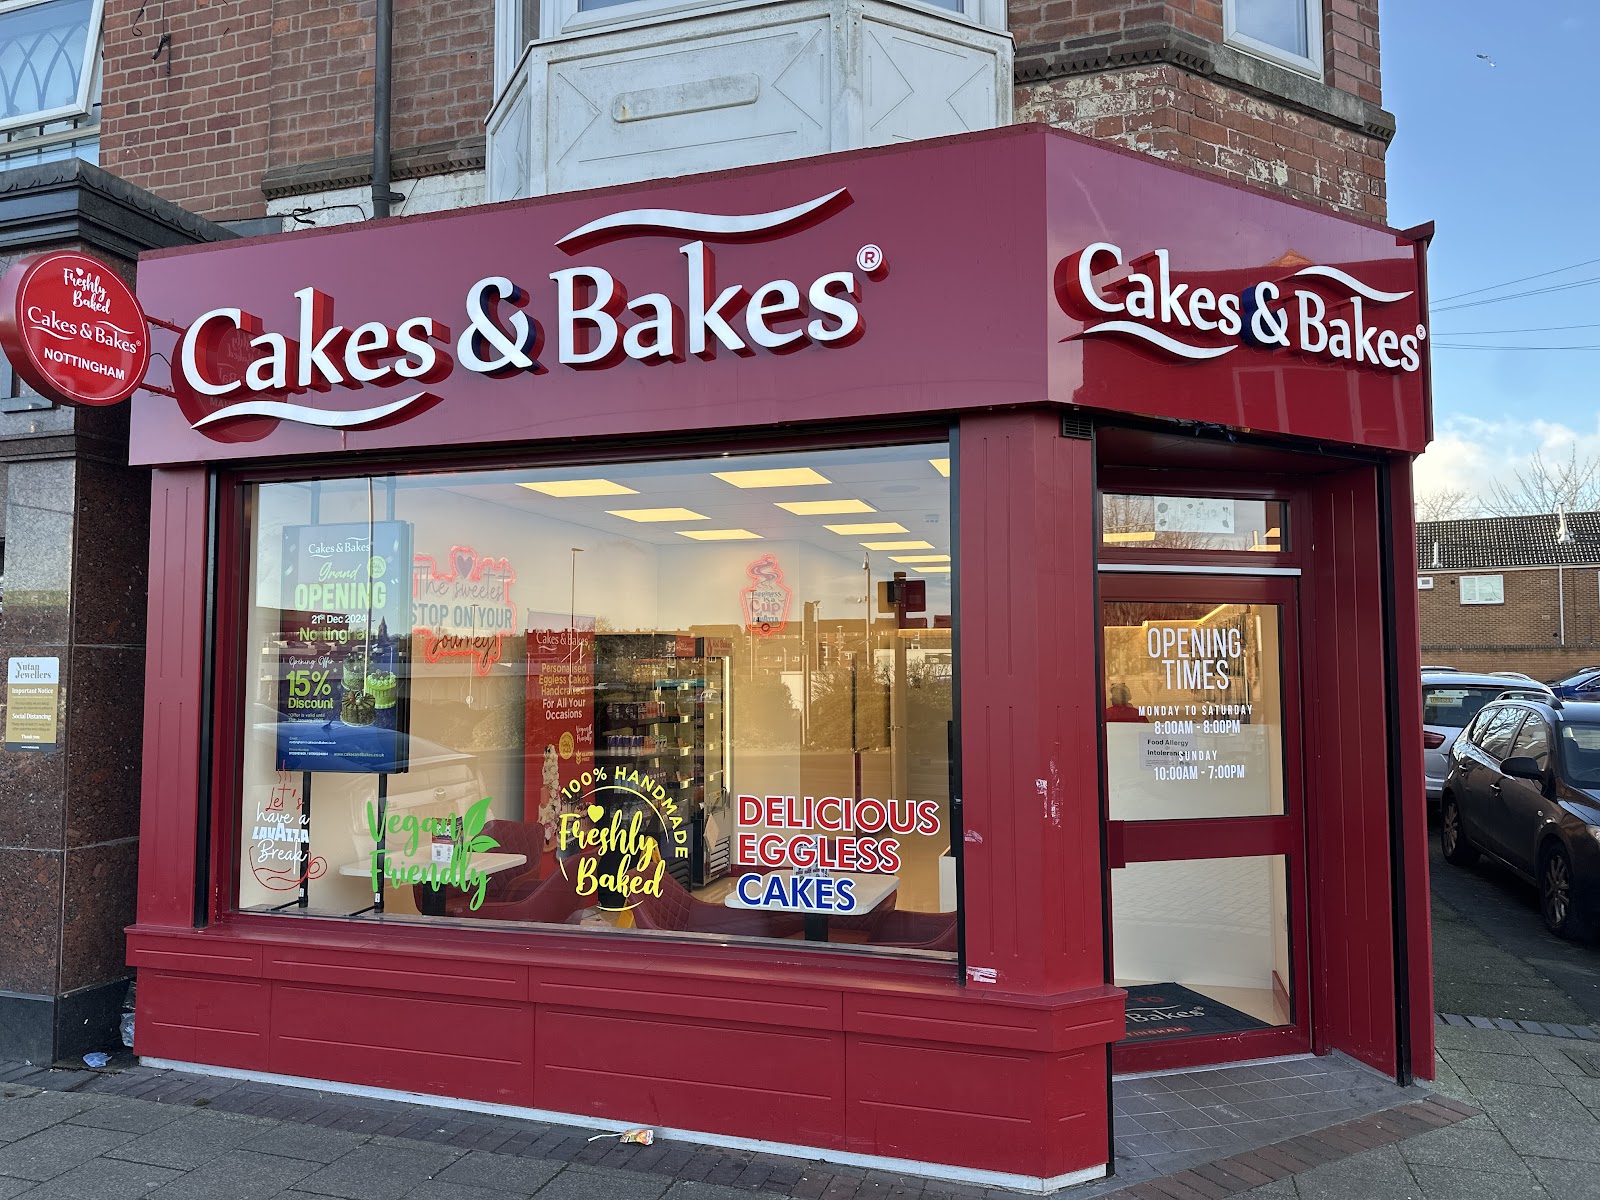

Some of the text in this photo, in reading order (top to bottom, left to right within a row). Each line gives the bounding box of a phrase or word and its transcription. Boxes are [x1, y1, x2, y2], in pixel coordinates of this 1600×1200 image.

[63, 267, 107, 302] Freshly
[1079, 242, 1242, 335] Cakes
[1251, 281, 1290, 347] &
[73, 290, 111, 314] Baked
[28, 306, 77, 335] Cakes
[80, 323, 93, 340] &
[182, 287, 434, 395] Cakes
[457, 276, 533, 373] &
[44, 347, 125, 380] NOTTINGHAM
[309, 542, 334, 554] Cakes
[336, 542, 343, 553] &
[319, 561, 361, 582] Grand
[295, 581, 386, 611] OPENING
[413, 566, 449, 601] The
[453, 566, 511, 602] sweetest
[311, 613, 366, 624] 21st Dec 2024
[409, 603, 512, 629] STOP ON YOUR
[749, 600, 780, 615] Cup
[300, 626, 378, 645] Nottingha
[536, 632, 559, 645] Cakes
[560, 632, 566, 645] &
[1147, 627, 1241, 659] OPENING
[16, 662, 40, 671] Nutan
[289, 655, 334, 669] Opening Offer
[541, 663, 586, 674] Personaised
[15, 670, 52, 679] Jewellers
[539, 674, 566, 686] Eggless
[1162, 659, 1230, 690] TIMES
[288, 698, 333, 709] Discount
[543, 698, 586, 709] For All Your
[545, 709, 582, 720] Occasions
[1138, 704, 1253, 717] MONDAY TO SATURDAY
[1154, 720, 1193, 735] 8:00AM
[1203, 719, 1241, 734] 8:00PM
[1165, 739, 1189, 747] Allergy
[1178, 750, 1218, 761] SUNDAY
[1154, 766, 1198, 780] 10:00AM
[1208, 765, 1245, 779] 7:00PM
[265, 783, 305, 811] Let's
[256, 801, 310, 825] have a
[561, 765, 688, 858] 100% HANDMADE
[738, 794, 941, 836] DELICIOUS
[252, 822, 309, 843] LAVAZZA
[366, 800, 462, 857] Vegan
[559, 809, 658, 872] Freshly
[257, 838, 307, 875] Break
[737, 832, 901, 874] EGGLESS
[369, 840, 491, 911] Friendly
[576, 854, 665, 898] Baked
[736, 873, 857, 912] CAKES
[1126, 1027, 1185, 1036] TINGHAM
